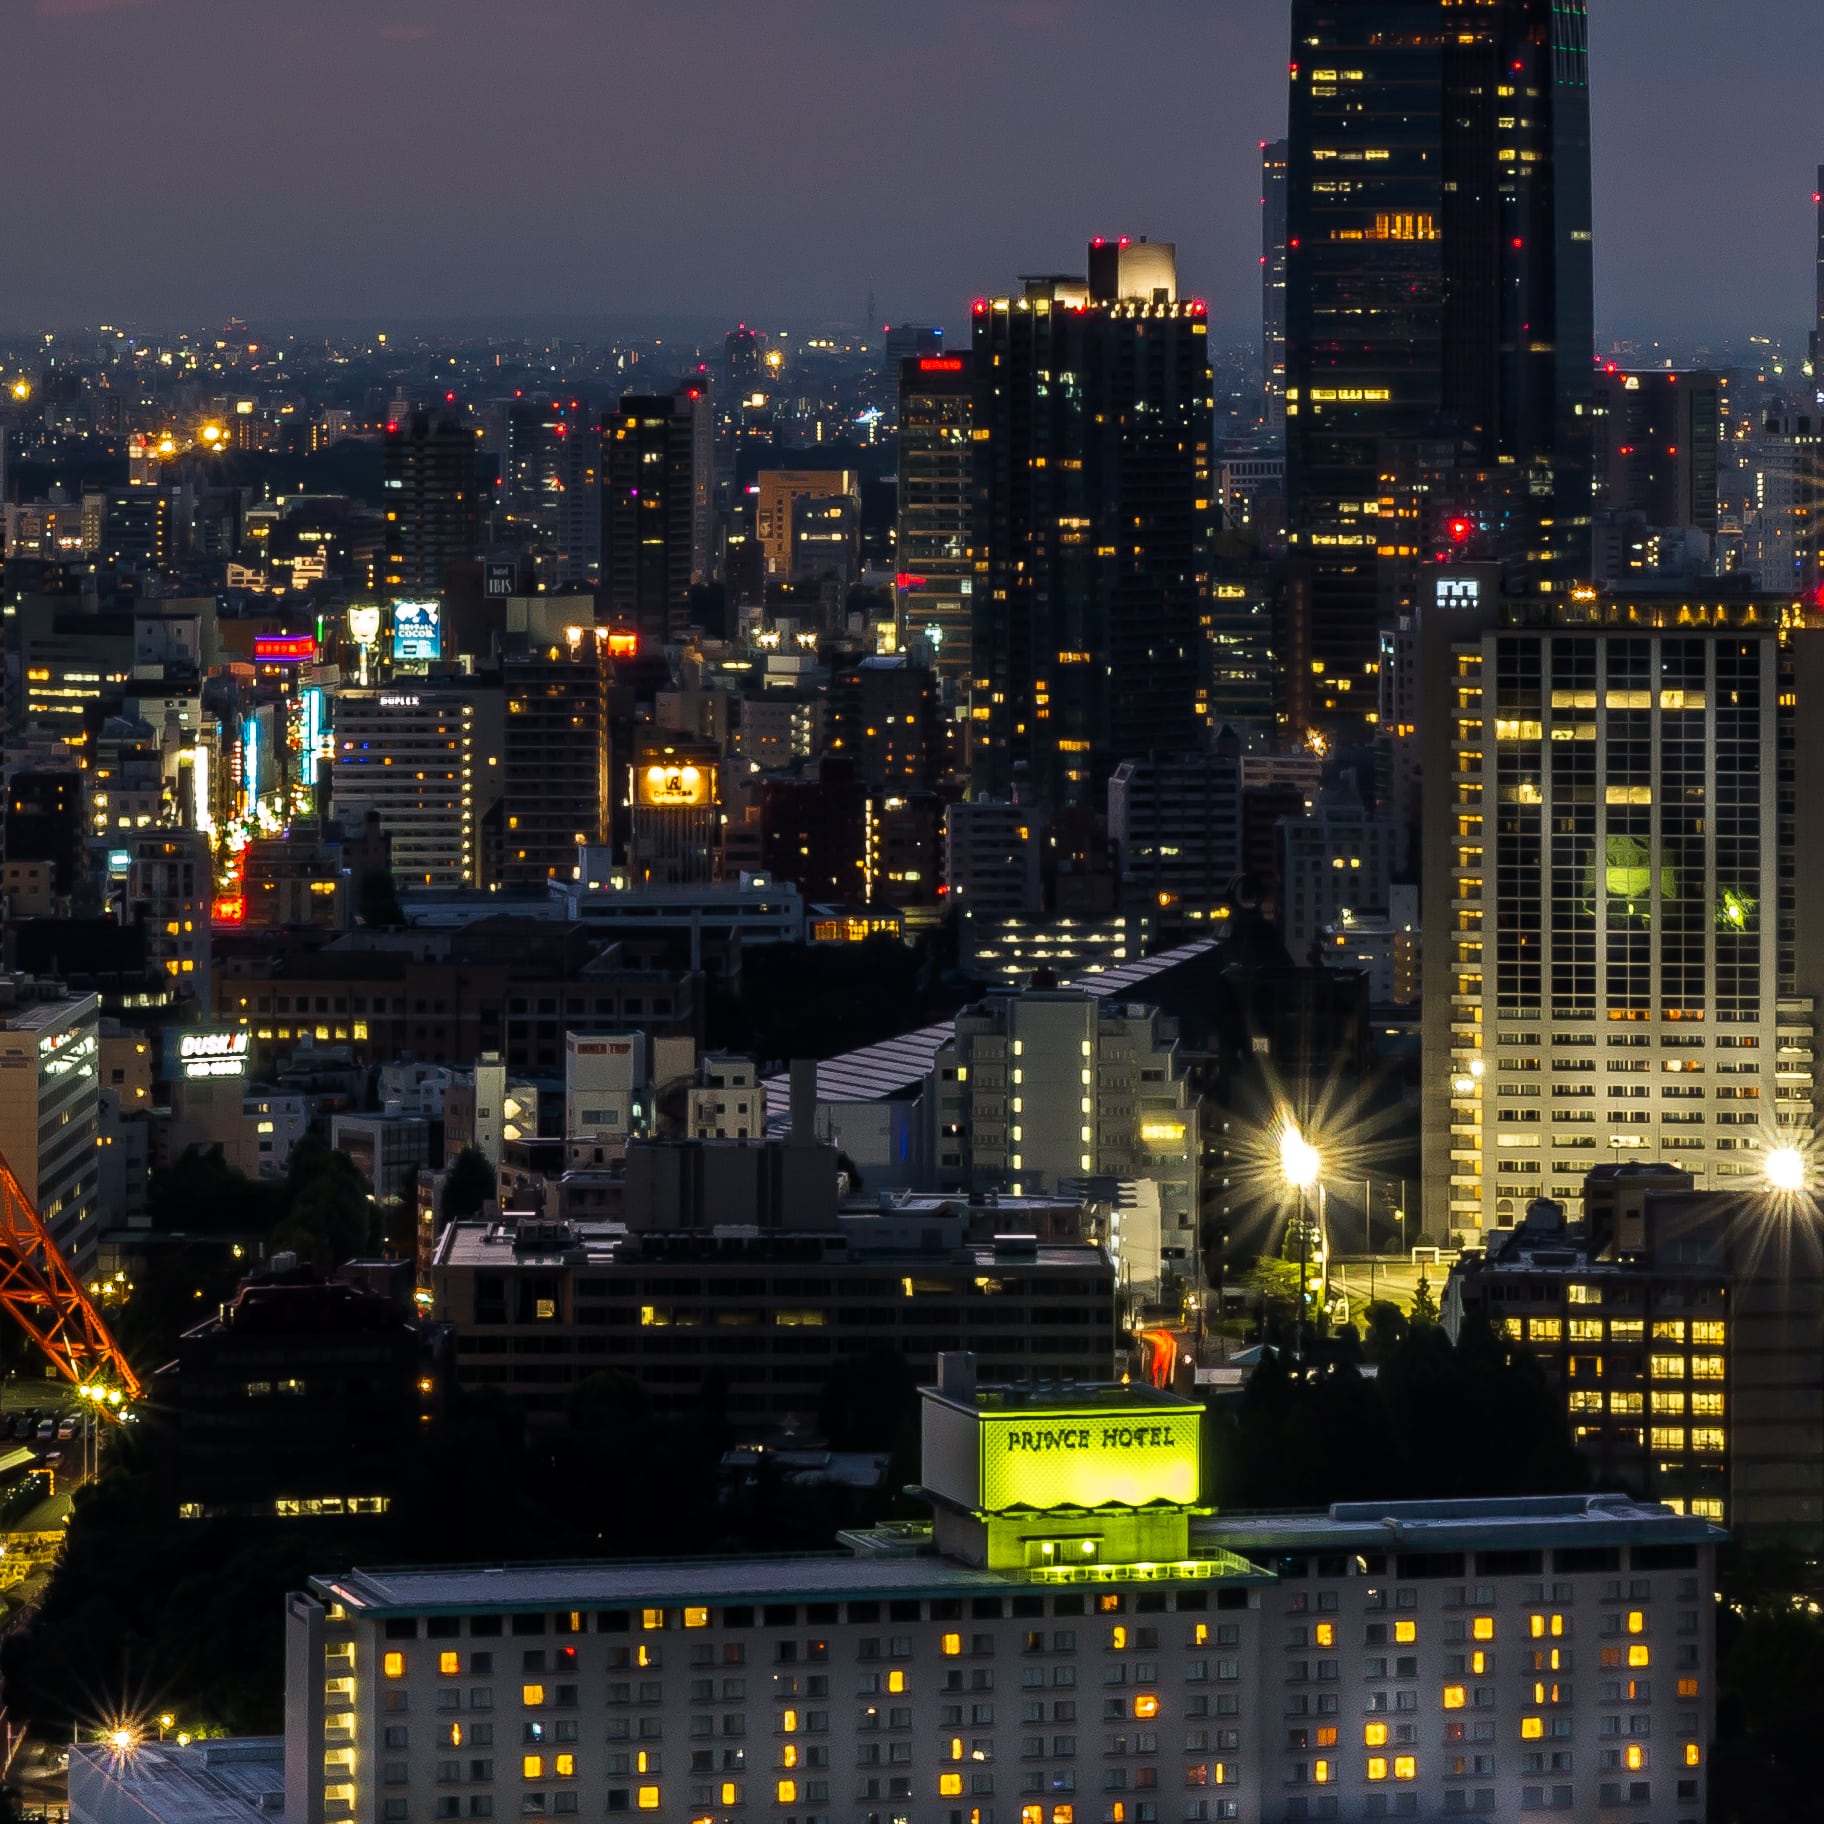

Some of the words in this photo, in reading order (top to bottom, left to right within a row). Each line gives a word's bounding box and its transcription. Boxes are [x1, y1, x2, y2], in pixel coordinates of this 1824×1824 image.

[489, 579, 512, 593] IBIS
[181, 1032, 248, 1056] DUSKIN
[1008, 1429, 1090, 1452] PRINCE
[1102, 1426, 1175, 1448] HOTEL
